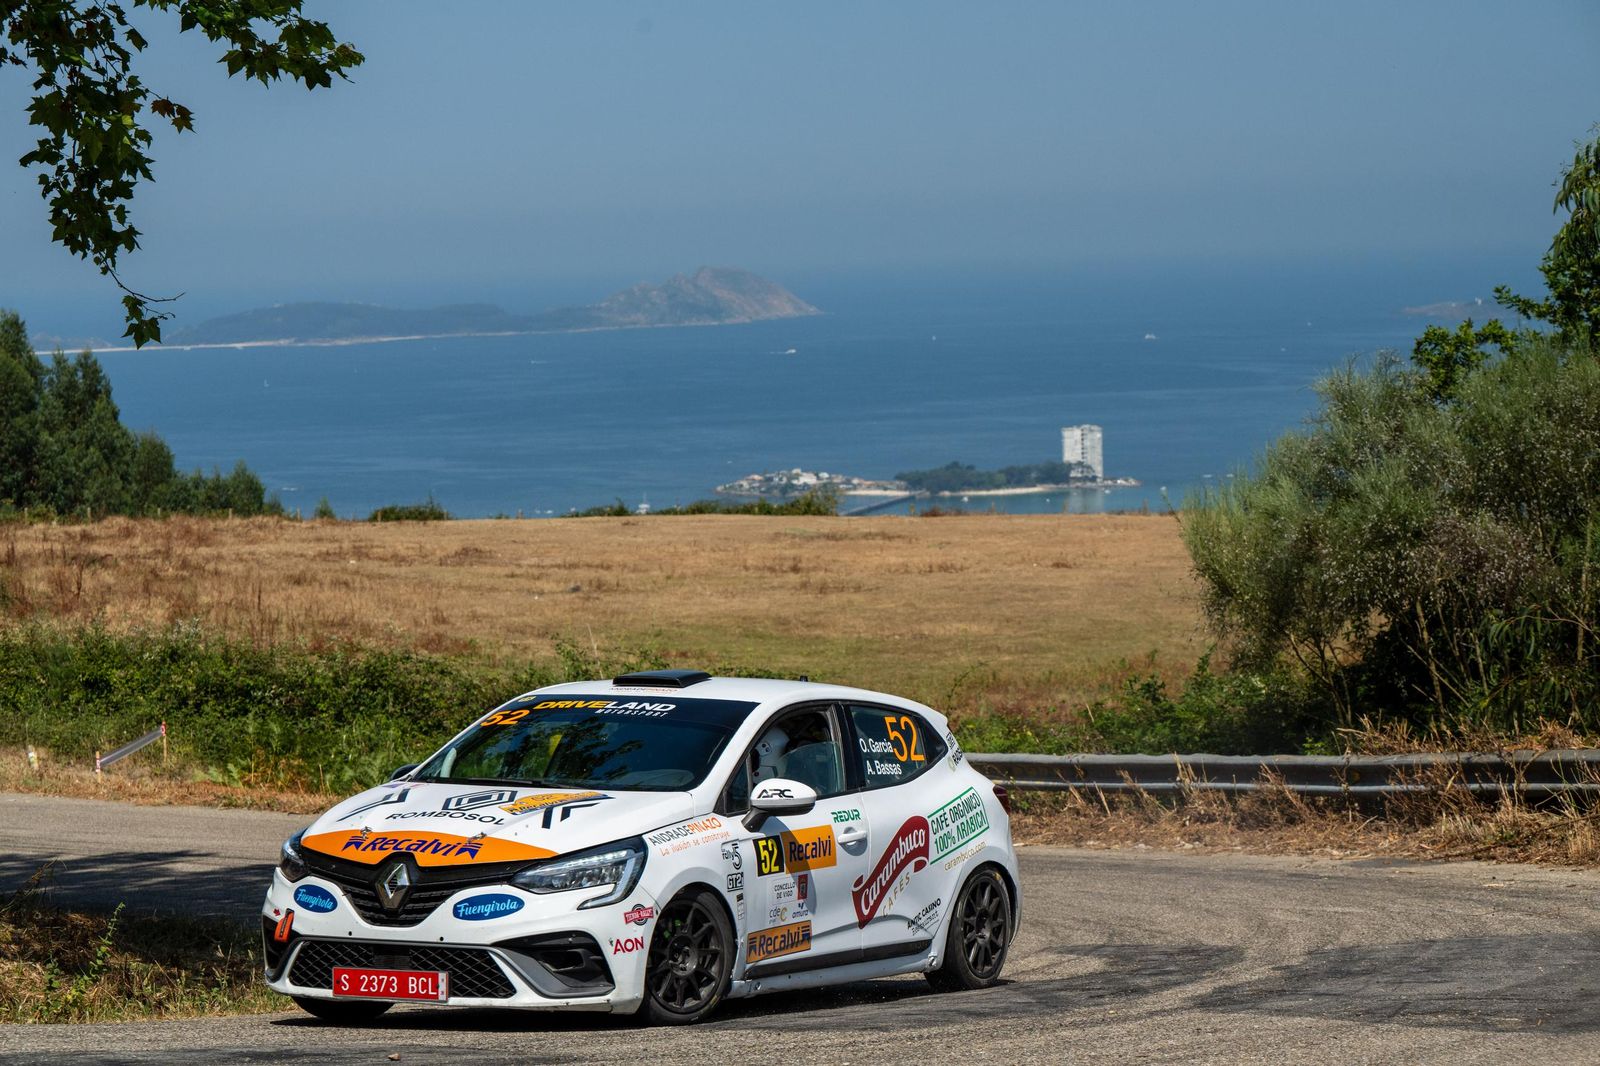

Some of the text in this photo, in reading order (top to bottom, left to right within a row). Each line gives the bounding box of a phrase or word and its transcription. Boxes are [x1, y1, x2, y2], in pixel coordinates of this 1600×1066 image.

[533, 700, 676, 711] DRIVELAND
[595, 708, 668, 718] MOTORSPORT
[481, 710, 530, 726] 52
[859, 738, 869, 752] O.
[885, 716, 924, 762] 52
[866, 760, 902, 774] A. Bassas
[757, 789, 793, 799] ARC
[385, 810, 505, 825] ROMBOSOL
[831, 809, 860, 823] REDUR
[931, 808, 950, 835] CAFÉ
[649, 817, 722, 846] ANDRADEPINAZO
[361, 837, 462, 856] Recalvi
[934, 828, 956, 854] 100%
[758, 836, 832, 874] 52 Recalvi
[861, 829, 925, 916] Carambuco
[774, 881, 795, 892] CONCELLO
[776, 890, 794, 899] DE VIGO
[296, 888, 334, 910] Fuengirola
[457, 899, 518, 917] Fuengirola
[613, 936, 644, 954] AON
[758, 926, 800, 956] Recalvi
[340, 974, 438, 995] S 2373 BCL
